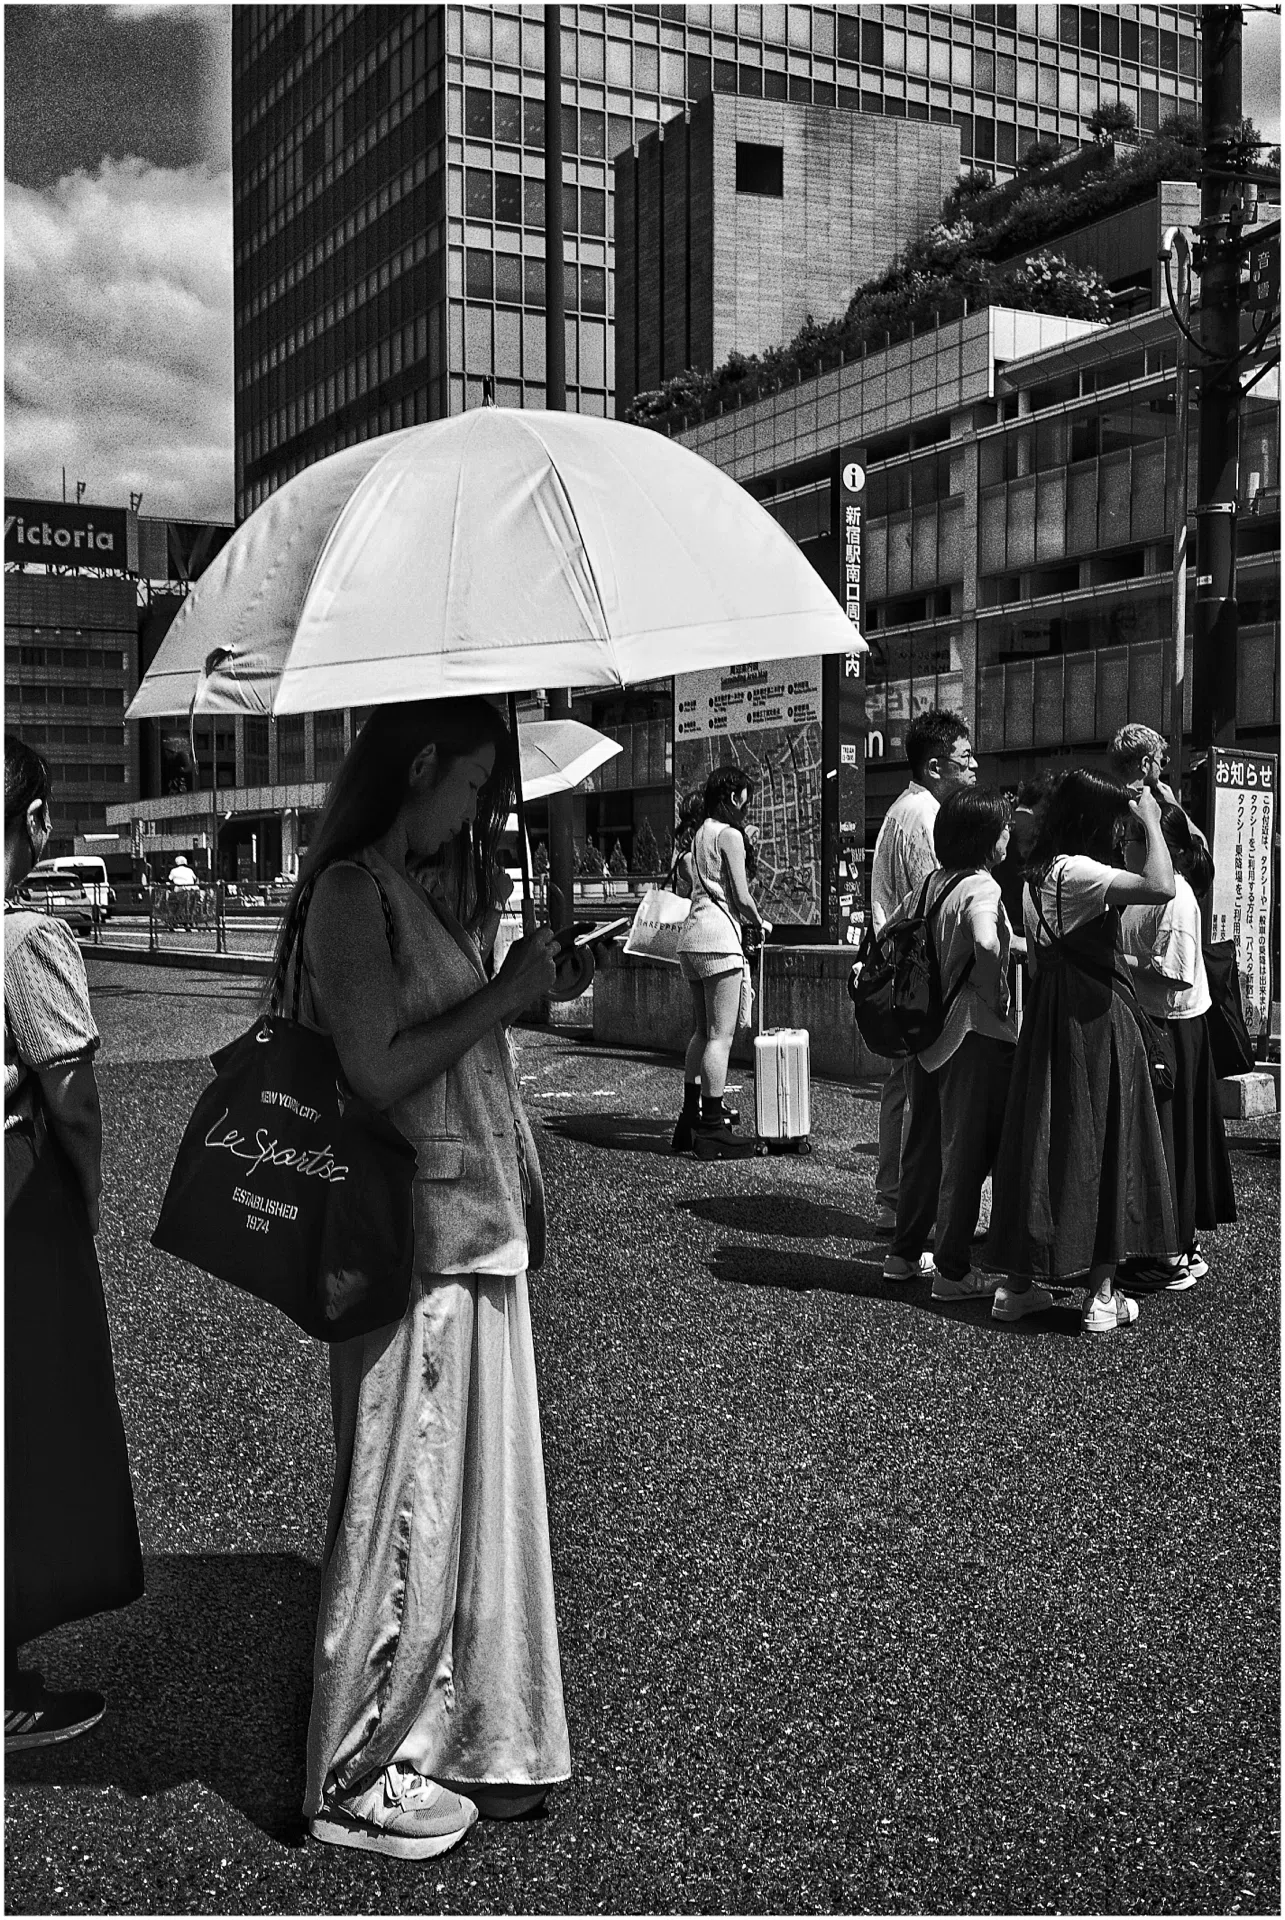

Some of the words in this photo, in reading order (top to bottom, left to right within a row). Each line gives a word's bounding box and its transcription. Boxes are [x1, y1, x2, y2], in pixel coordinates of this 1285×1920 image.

[845, 506, 861, 678] 新宿駅南口周内
[1215, 760, 1272, 788] お知らせ
[299, 1105, 321, 1123] CITY
[232, 1186, 299, 1221] ESTABLISHED
[245, 1214, 270, 1234] 1974
